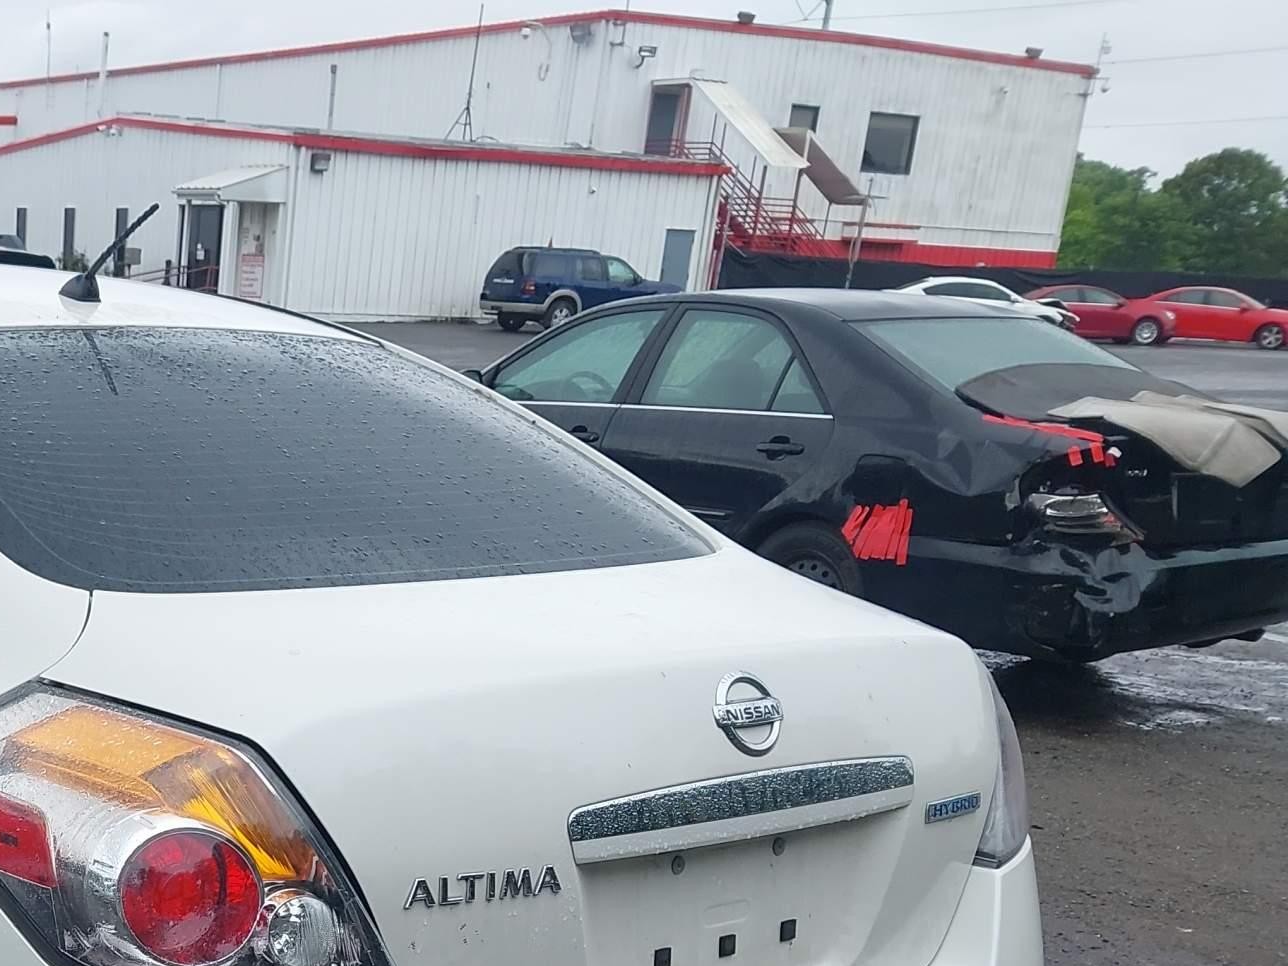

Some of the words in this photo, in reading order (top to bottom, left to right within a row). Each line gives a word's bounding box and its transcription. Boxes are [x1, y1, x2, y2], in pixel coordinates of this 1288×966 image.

[725, 703, 781, 722] NISSAN
[931, 795, 979, 818] HYBRID
[403, 864, 562, 910] ALTIMA
